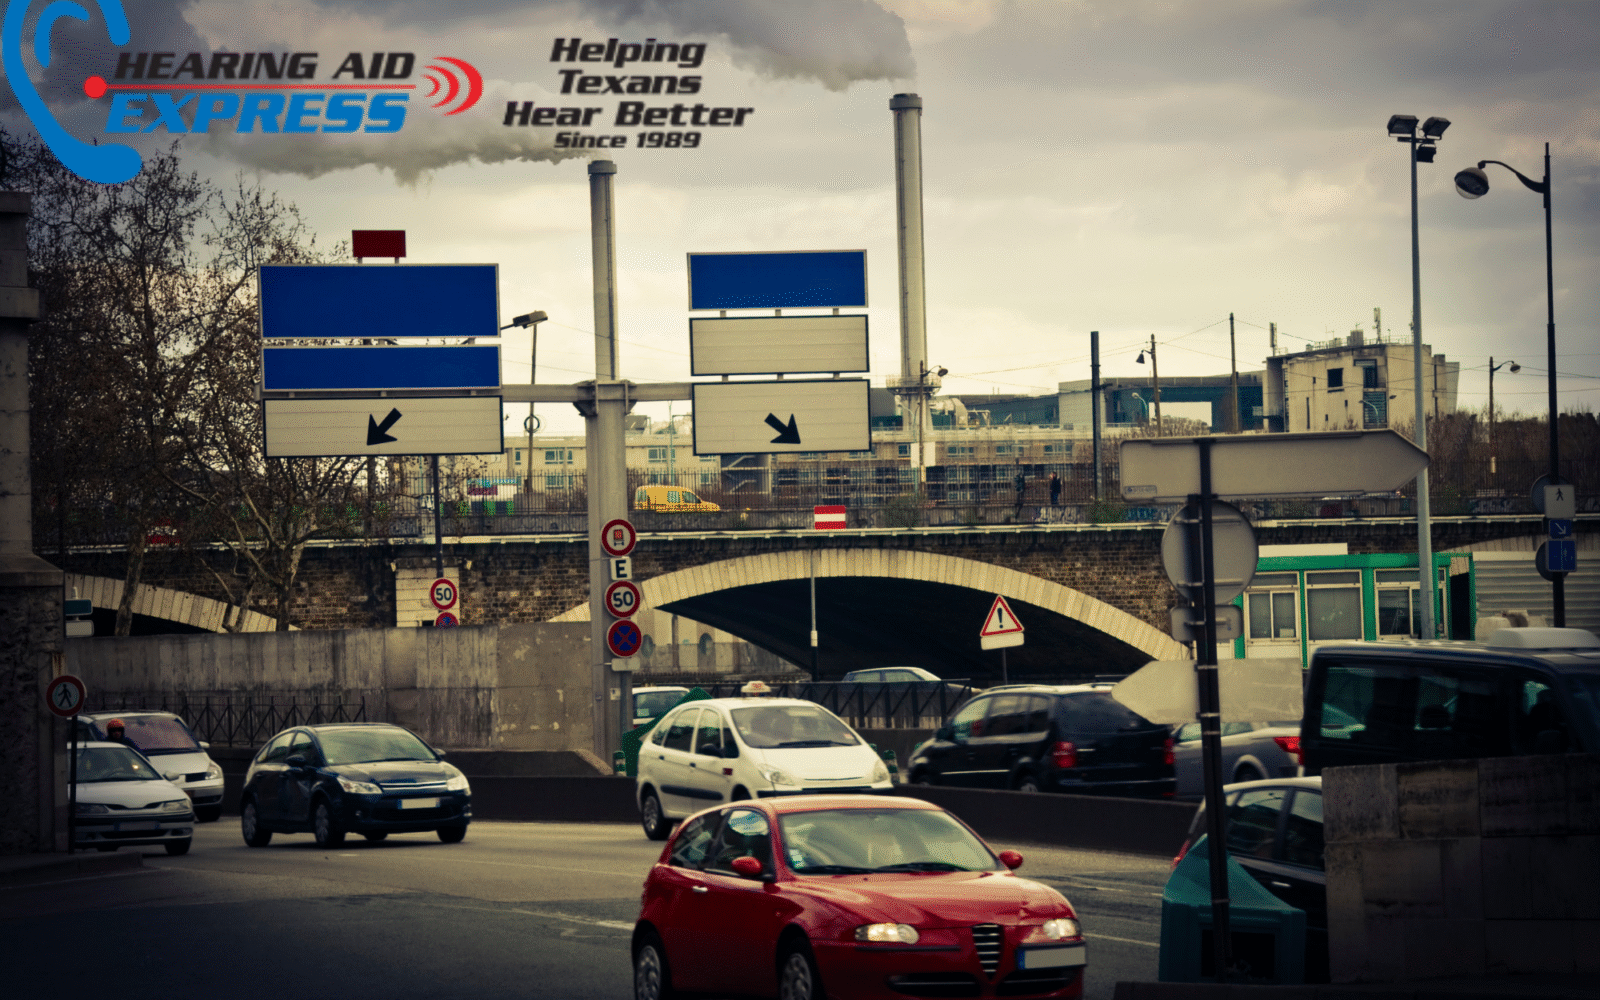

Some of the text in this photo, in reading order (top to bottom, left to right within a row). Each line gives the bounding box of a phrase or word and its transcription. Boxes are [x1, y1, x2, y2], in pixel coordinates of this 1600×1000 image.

[615, 559, 628, 579] E
[435, 587, 452, 602] 50
[612, 591, 634, 608] 50
